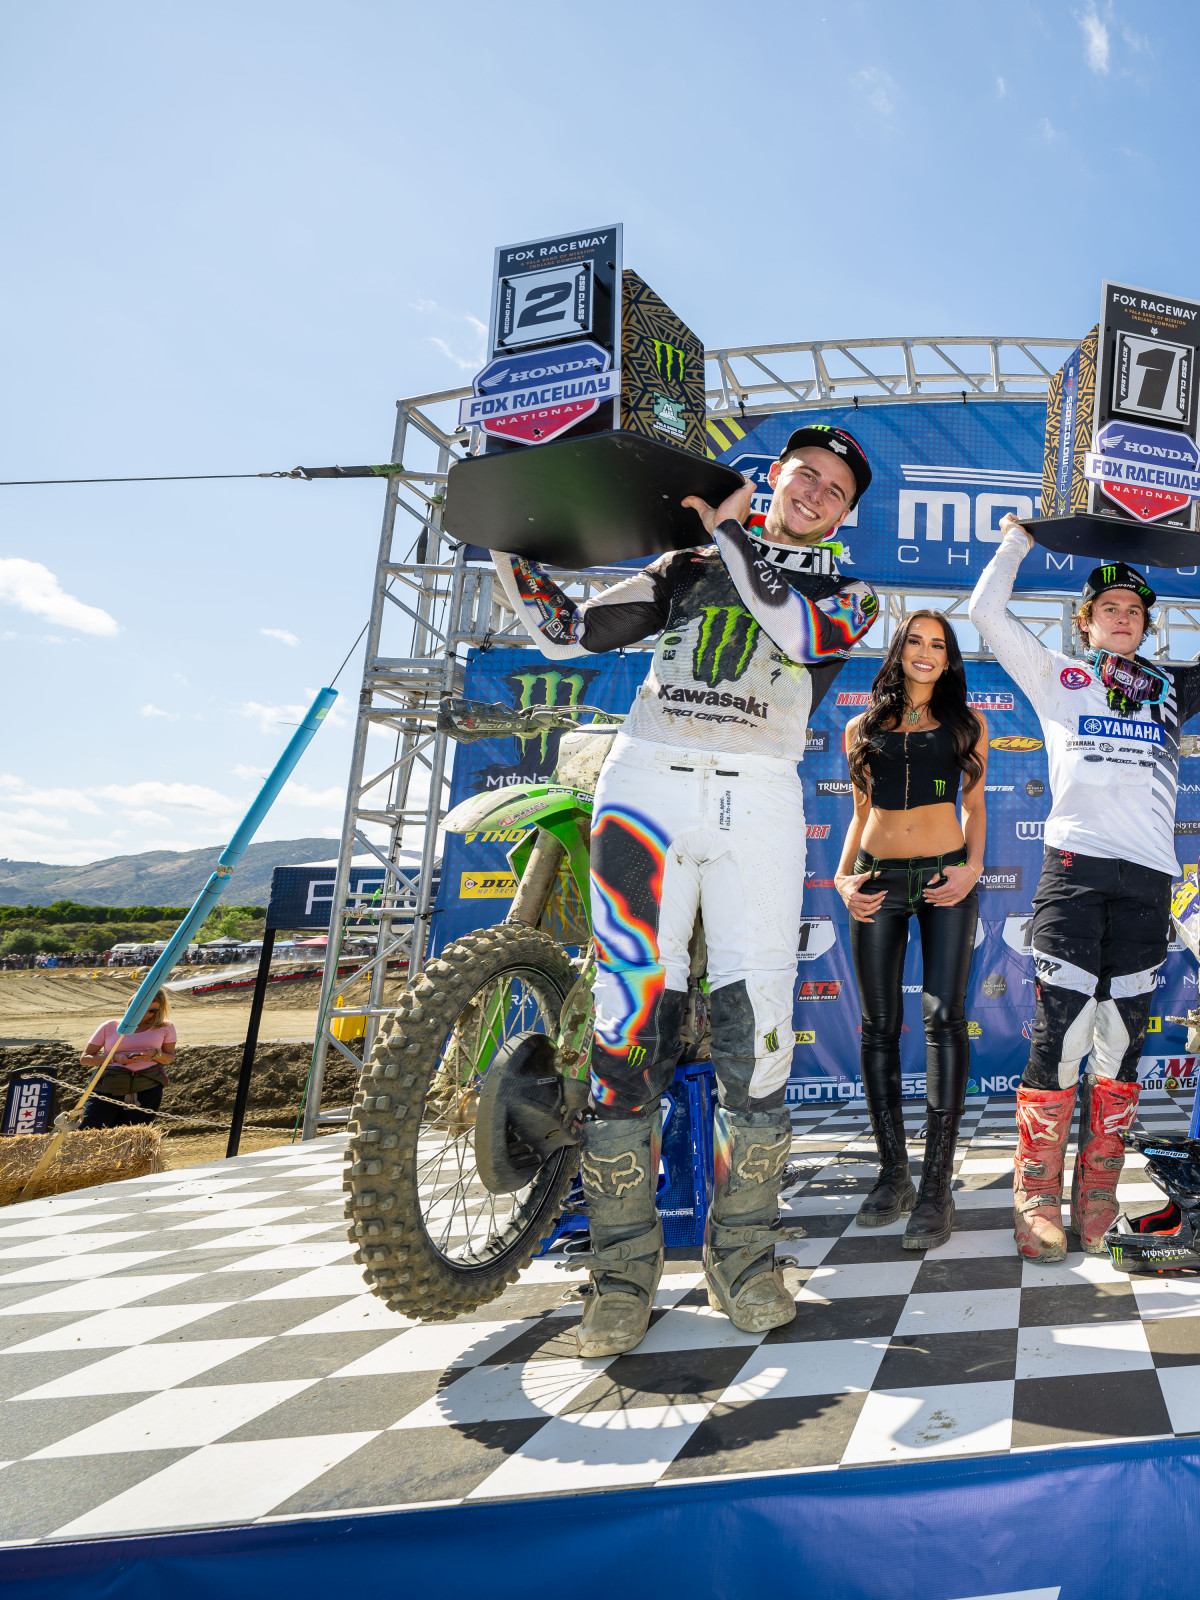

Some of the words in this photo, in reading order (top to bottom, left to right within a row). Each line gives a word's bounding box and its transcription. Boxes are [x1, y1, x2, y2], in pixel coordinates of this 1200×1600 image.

[507, 249, 535, 262] FOX
[540, 236, 608, 256] RACEWAY
[517, 281, 573, 328] 2
[1113, 292, 1137, 307] FOX
[1140, 299, 1198, 321] RACEWAY
[509, 357, 603, 383] HONDA
[1121, 346, 1129, 374] PLACE
[1120, 374, 1128, 397] FIRST
[1135, 348, 1177, 411] 1
[470, 399, 509, 418] FOX
[512, 376, 611, 408] RACEWAY
[1179, 379, 1187, 410] CLASS
[496, 404, 584, 427] NATIONAL
[1123, 441, 1196, 463] HONDA
[1092, 458, 1123, 479] FOX
[1125, 464, 1200, 492] RACEWAY
[1112, 484, 1180, 502] NATIONAL
[753, 560, 783, 595] FOX
[658, 684, 769, 720] Kawasaki
[966, 692, 1013, 704] ARTS
[662, 706, 693, 718] PRO
[693, 711, 758, 728] CIRCUIT
[1102, 719, 1161, 742] YAMAHA
[989, 737, 1044, 749] FMF
[486, 772, 551, 788] MONS
[817, 782, 854, 791] TRIUMP
[480, 829, 528, 843] THO
[479, 879, 519, 888] DUN
[978, 873, 1016, 885] qvarna
[801, 982, 841, 996] ETS
[1142, 1057, 1200, 1080] AM
[784, 1078, 927, 1100] MOTOSS
[981, 1074, 1021, 1093] NBC
[1141, 1079, 1163, 1091] 100
[1179, 1077, 1198, 1089] YEA
[1141, 1248, 1192, 1259] MONSTER
